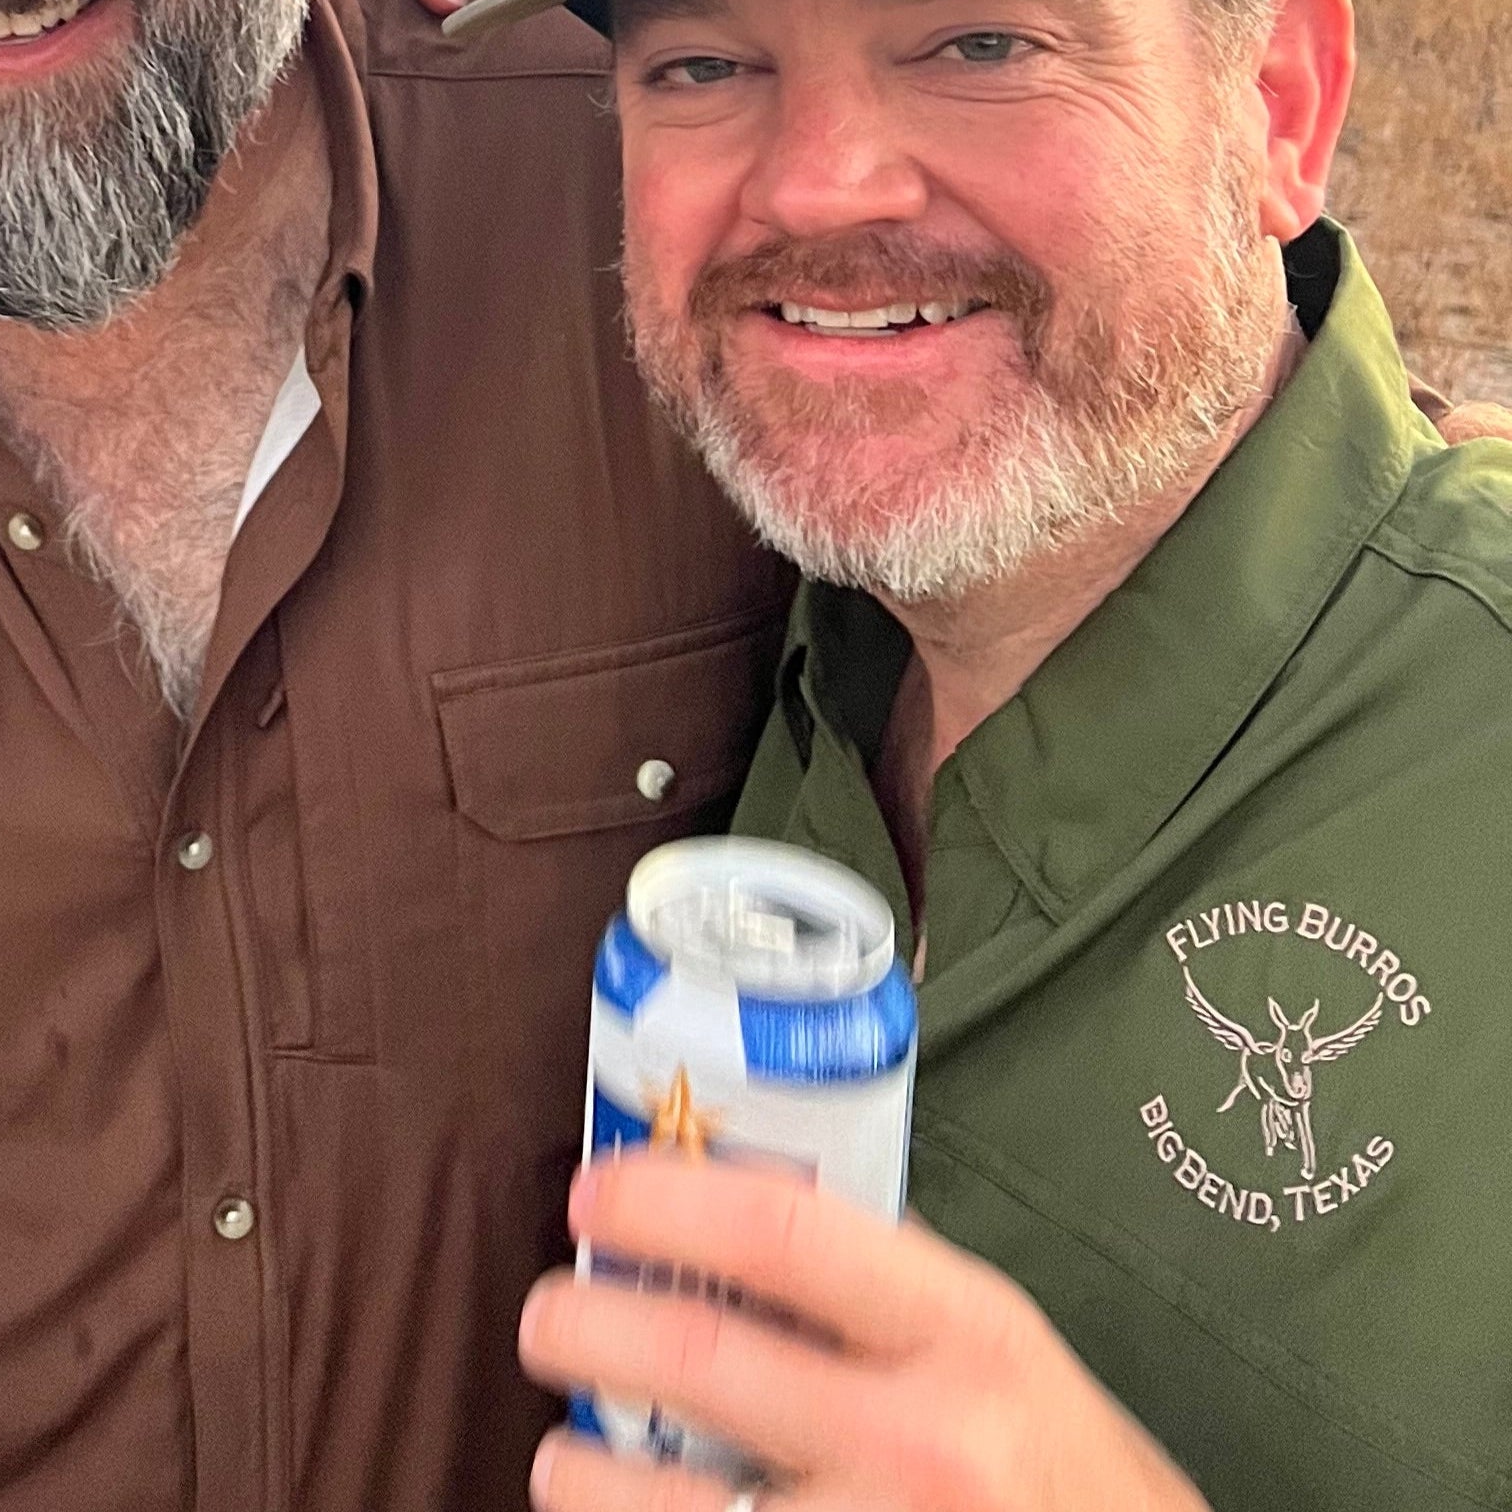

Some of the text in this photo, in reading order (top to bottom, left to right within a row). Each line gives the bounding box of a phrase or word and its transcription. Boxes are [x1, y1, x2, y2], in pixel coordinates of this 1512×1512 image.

[1166, 900, 1432, 1027] FLYING BURROS
[1139, 1094, 1395, 1233] BIG BEND, TEXAS
